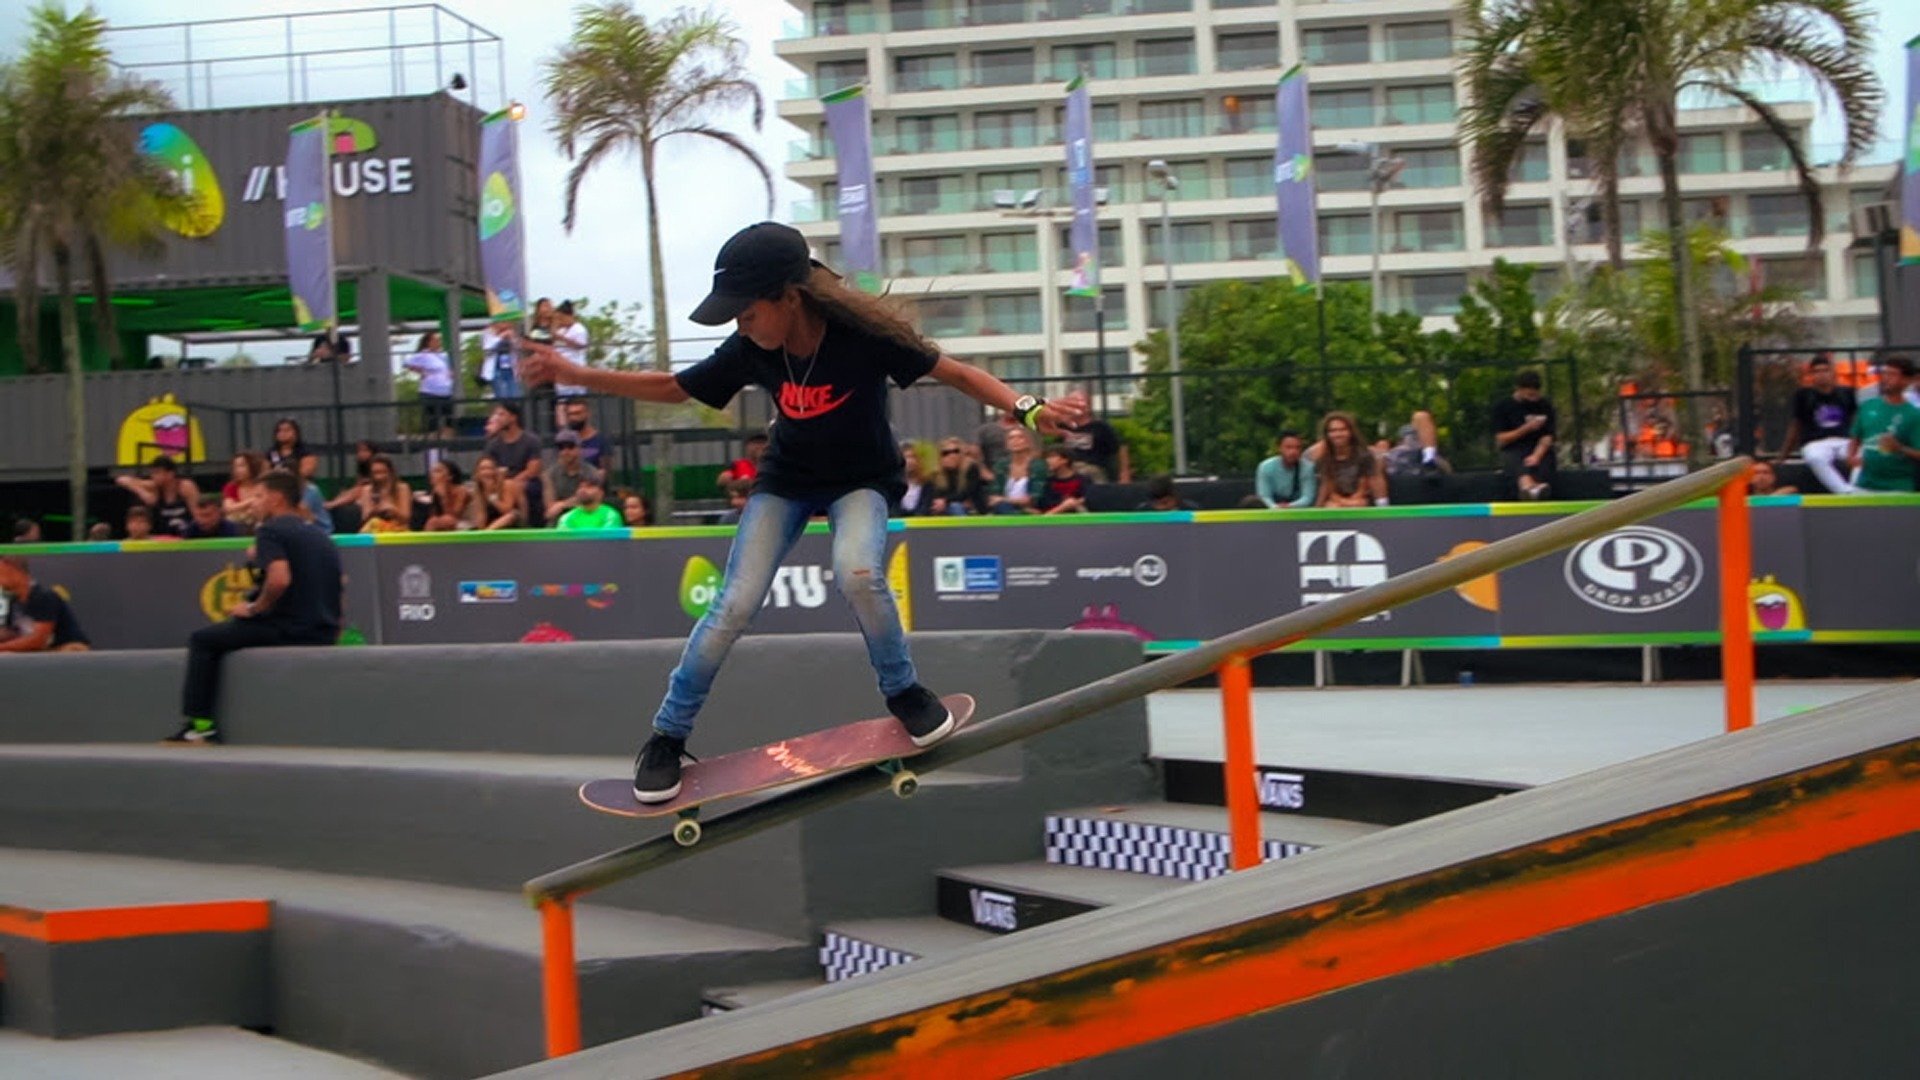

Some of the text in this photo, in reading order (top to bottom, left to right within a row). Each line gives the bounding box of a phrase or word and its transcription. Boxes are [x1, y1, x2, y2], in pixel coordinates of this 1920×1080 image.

[780, 381, 833, 408] NIKE
[1583, 579, 1688, 606] DROP DEAD
[399, 603, 436, 621] RIO
[1254, 772, 1304, 809] VANS
[969, 888, 1017, 930] VANS
